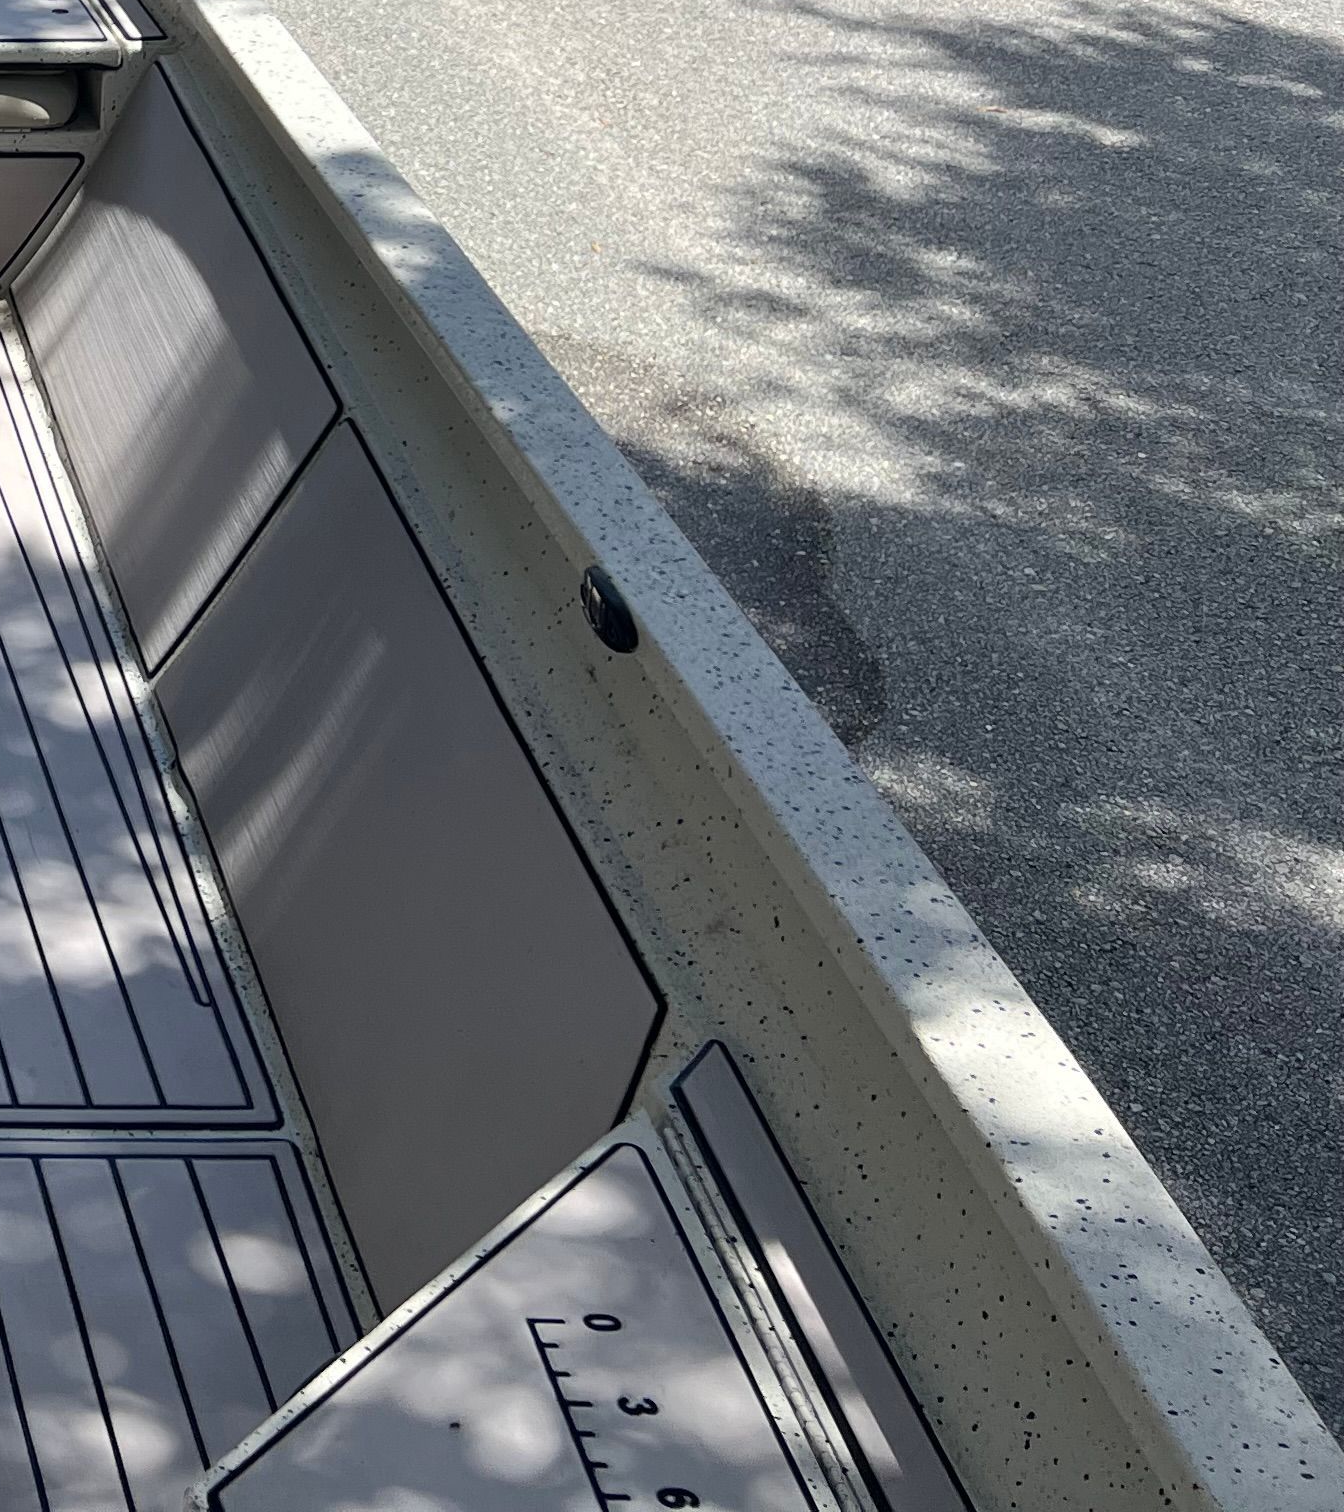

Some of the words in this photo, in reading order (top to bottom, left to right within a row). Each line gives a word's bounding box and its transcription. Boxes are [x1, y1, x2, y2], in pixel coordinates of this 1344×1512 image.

[583, 1313, 622, 1332] 0
[617, 1396, 659, 1416] 3
[656, 1487, 701, 1509] 6
